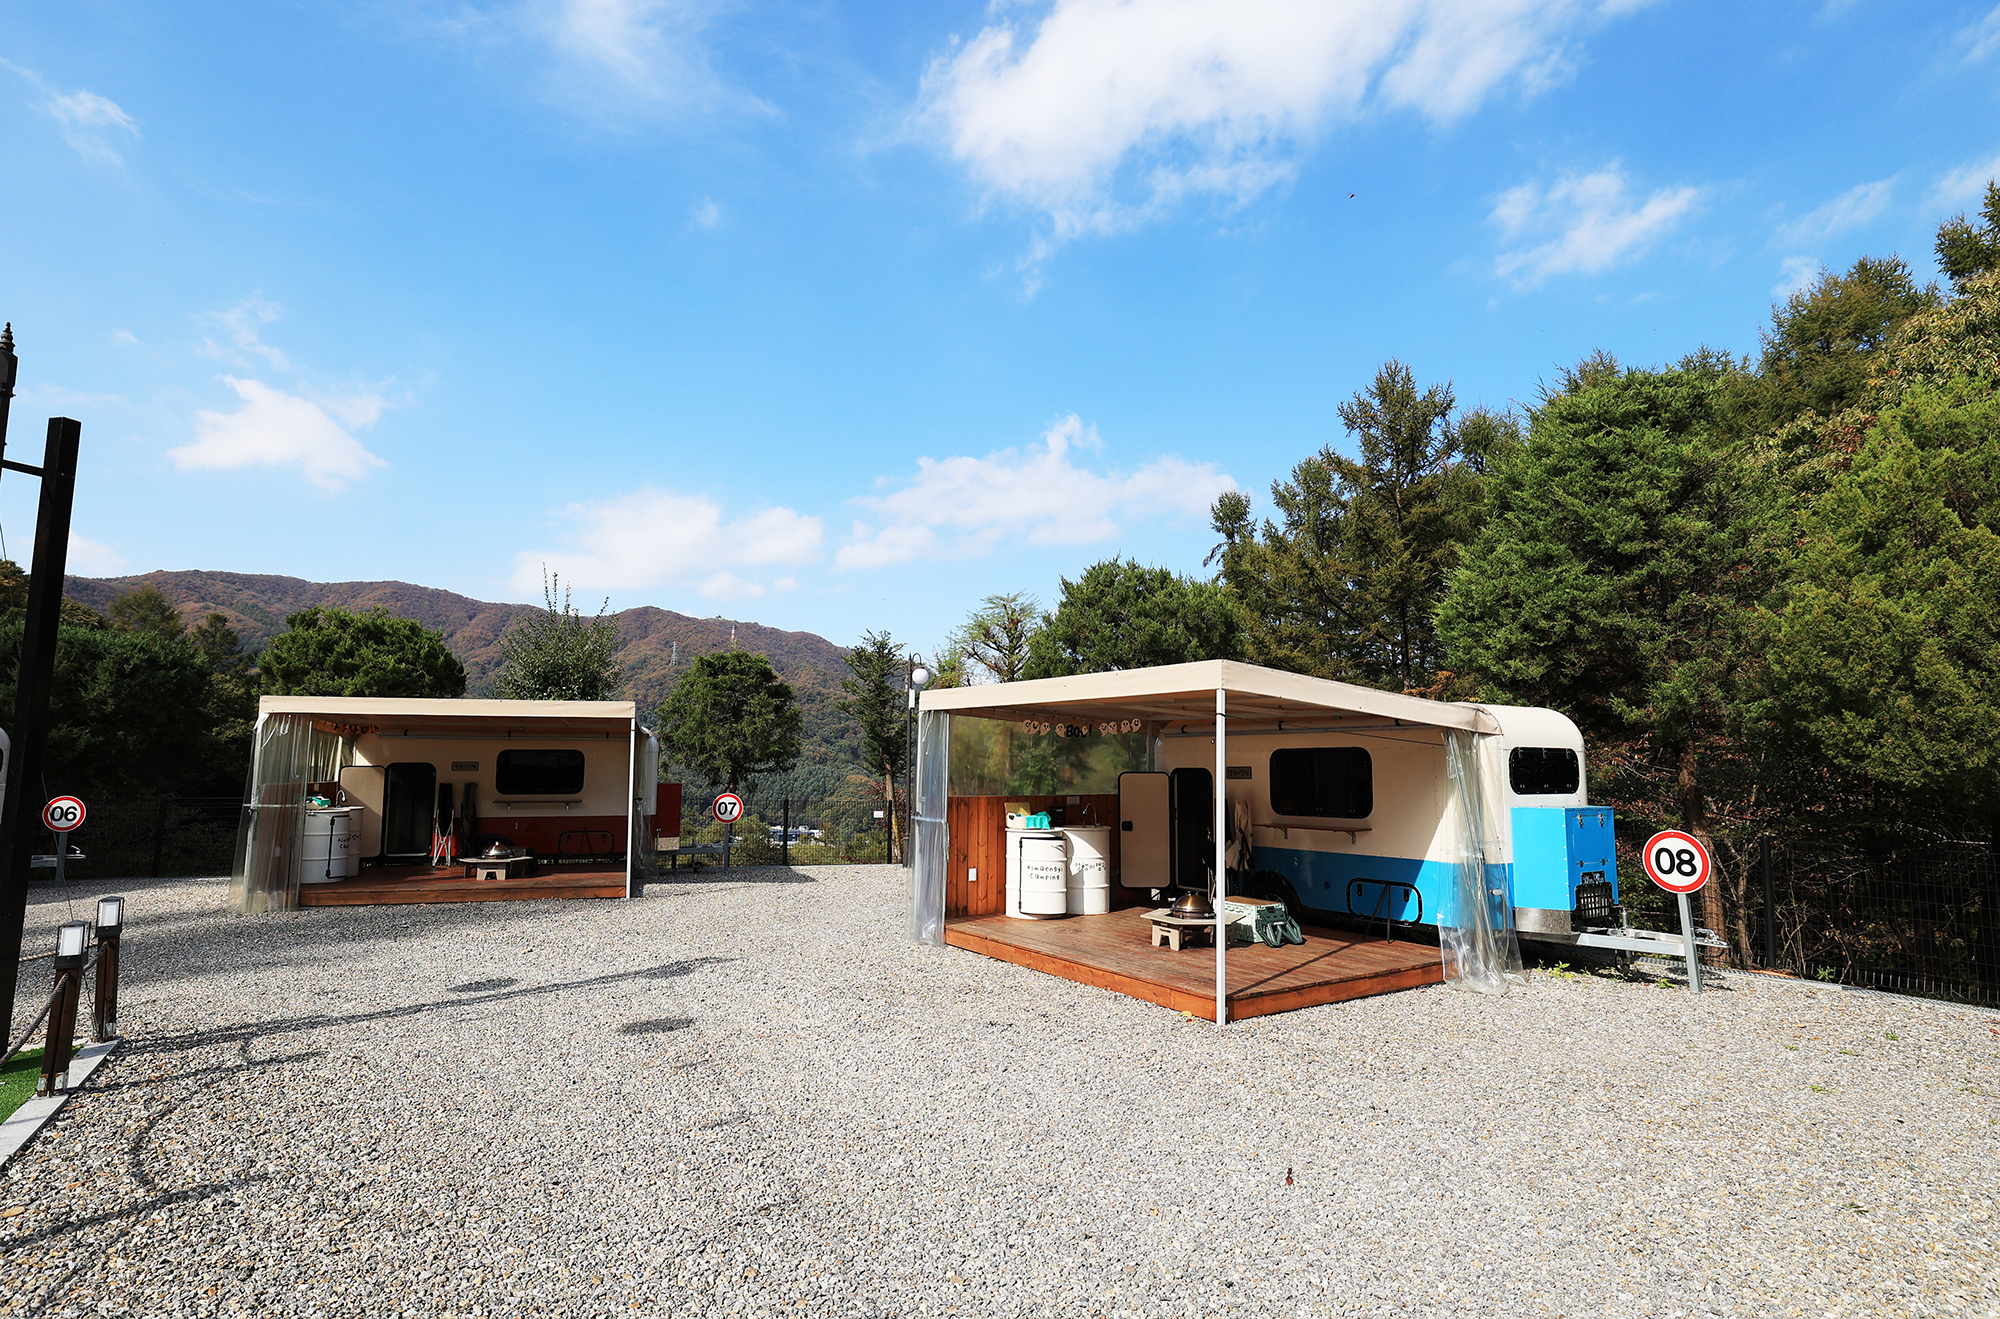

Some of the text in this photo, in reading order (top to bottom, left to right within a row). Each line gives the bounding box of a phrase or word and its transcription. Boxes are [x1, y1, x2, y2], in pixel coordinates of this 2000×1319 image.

[51, 805, 77, 822] 06
[718, 801, 737, 815] 07
[1655, 847, 1697, 877] 08
